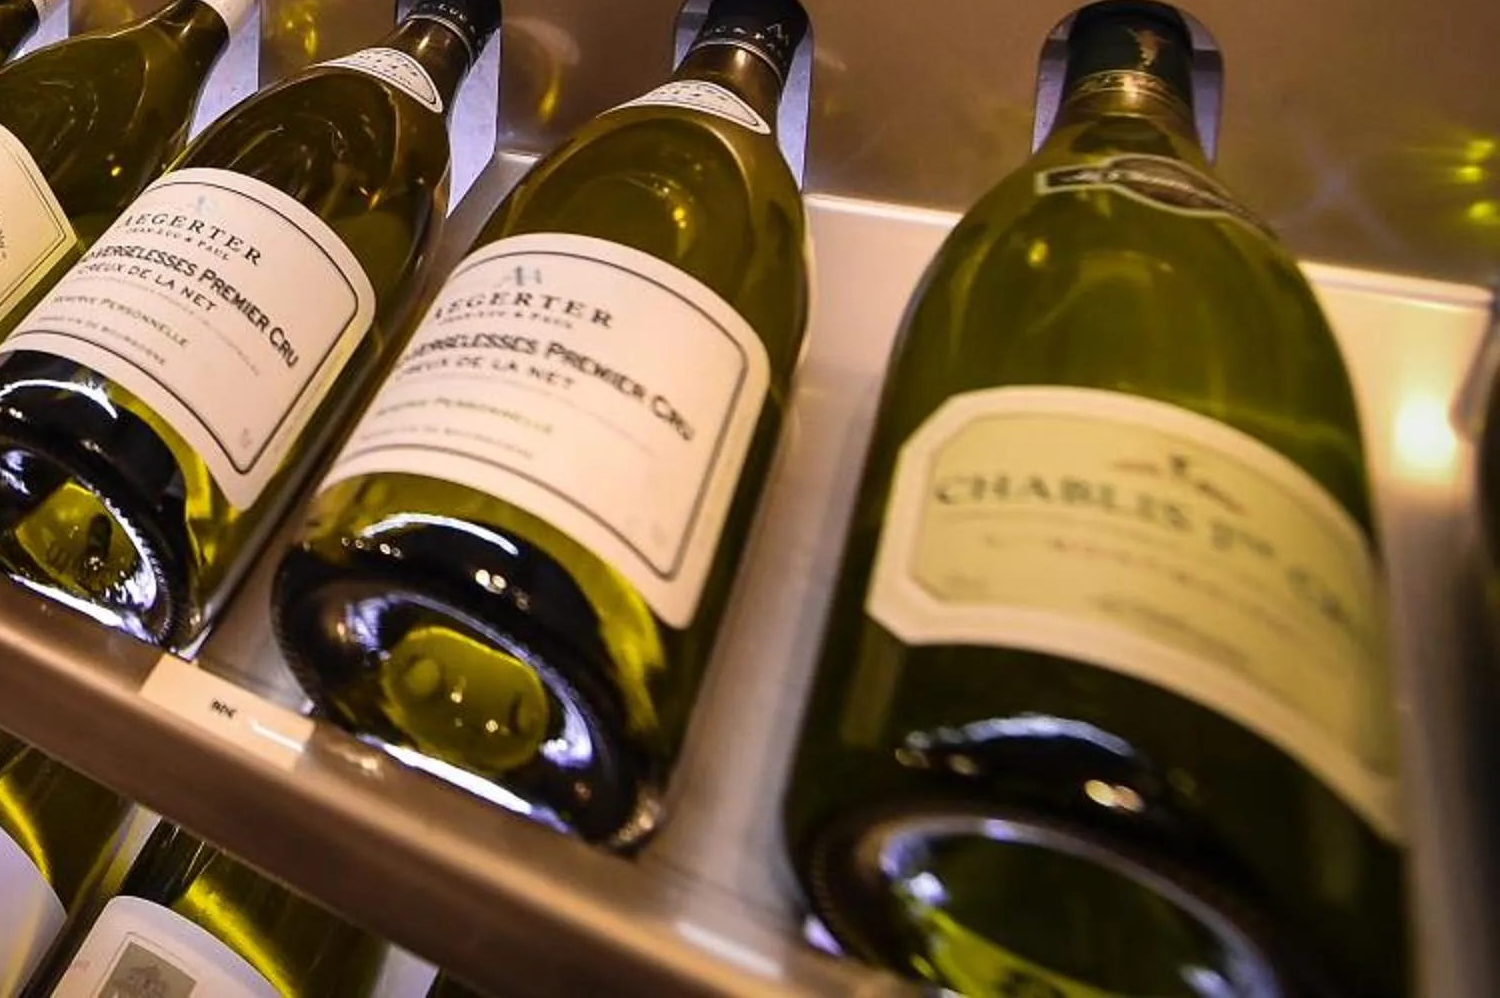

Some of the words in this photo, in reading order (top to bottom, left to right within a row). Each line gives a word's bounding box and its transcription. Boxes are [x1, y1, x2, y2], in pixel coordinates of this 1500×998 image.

[127, 265, 152, 279] DE
[154, 274, 176, 291] LA
[180, 286, 218, 313] NET
[199, 268, 273, 334] PREMIER
[934, 475, 1192, 534] CHABLIS
